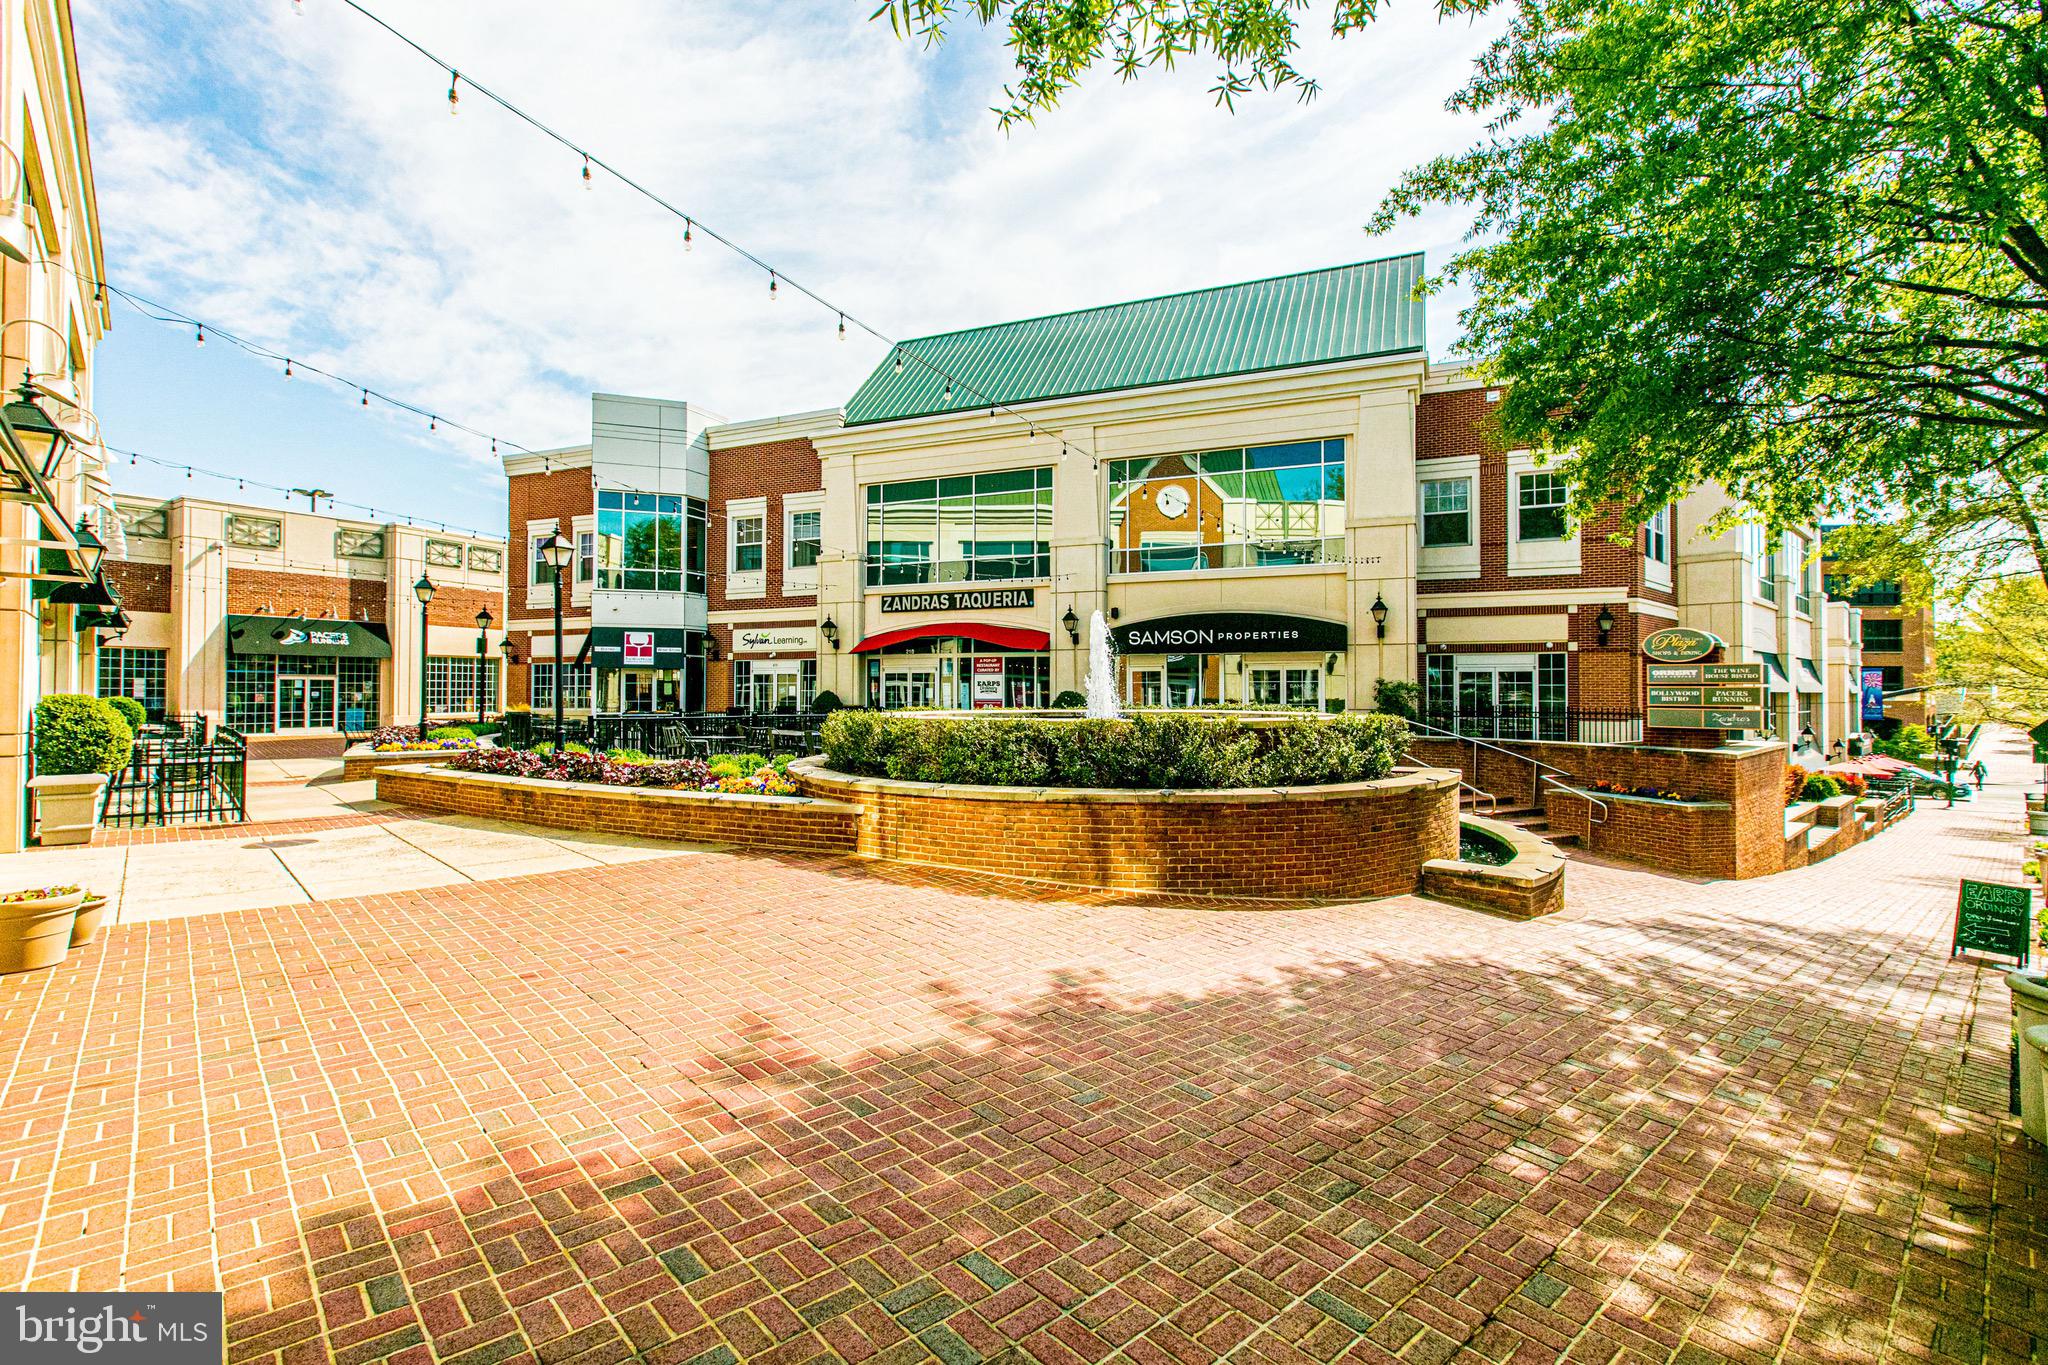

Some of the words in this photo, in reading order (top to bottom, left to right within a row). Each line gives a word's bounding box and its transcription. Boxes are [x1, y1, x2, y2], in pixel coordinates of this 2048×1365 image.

[882, 595, 949, 611] ZANDRAS
[310, 631, 349, 639] PACERS
[310, 637, 350, 646] RUNNING
[742, 632, 773, 649] Sylvan
[773, 636, 804, 646] Learning
[1128, 629, 1214, 645] SAMSON
[1217, 631, 1299, 640] PROPERTIES
[1651, 633, 1697, 651] Plaza
[1964, 899, 2024, 917] ORDINARY
